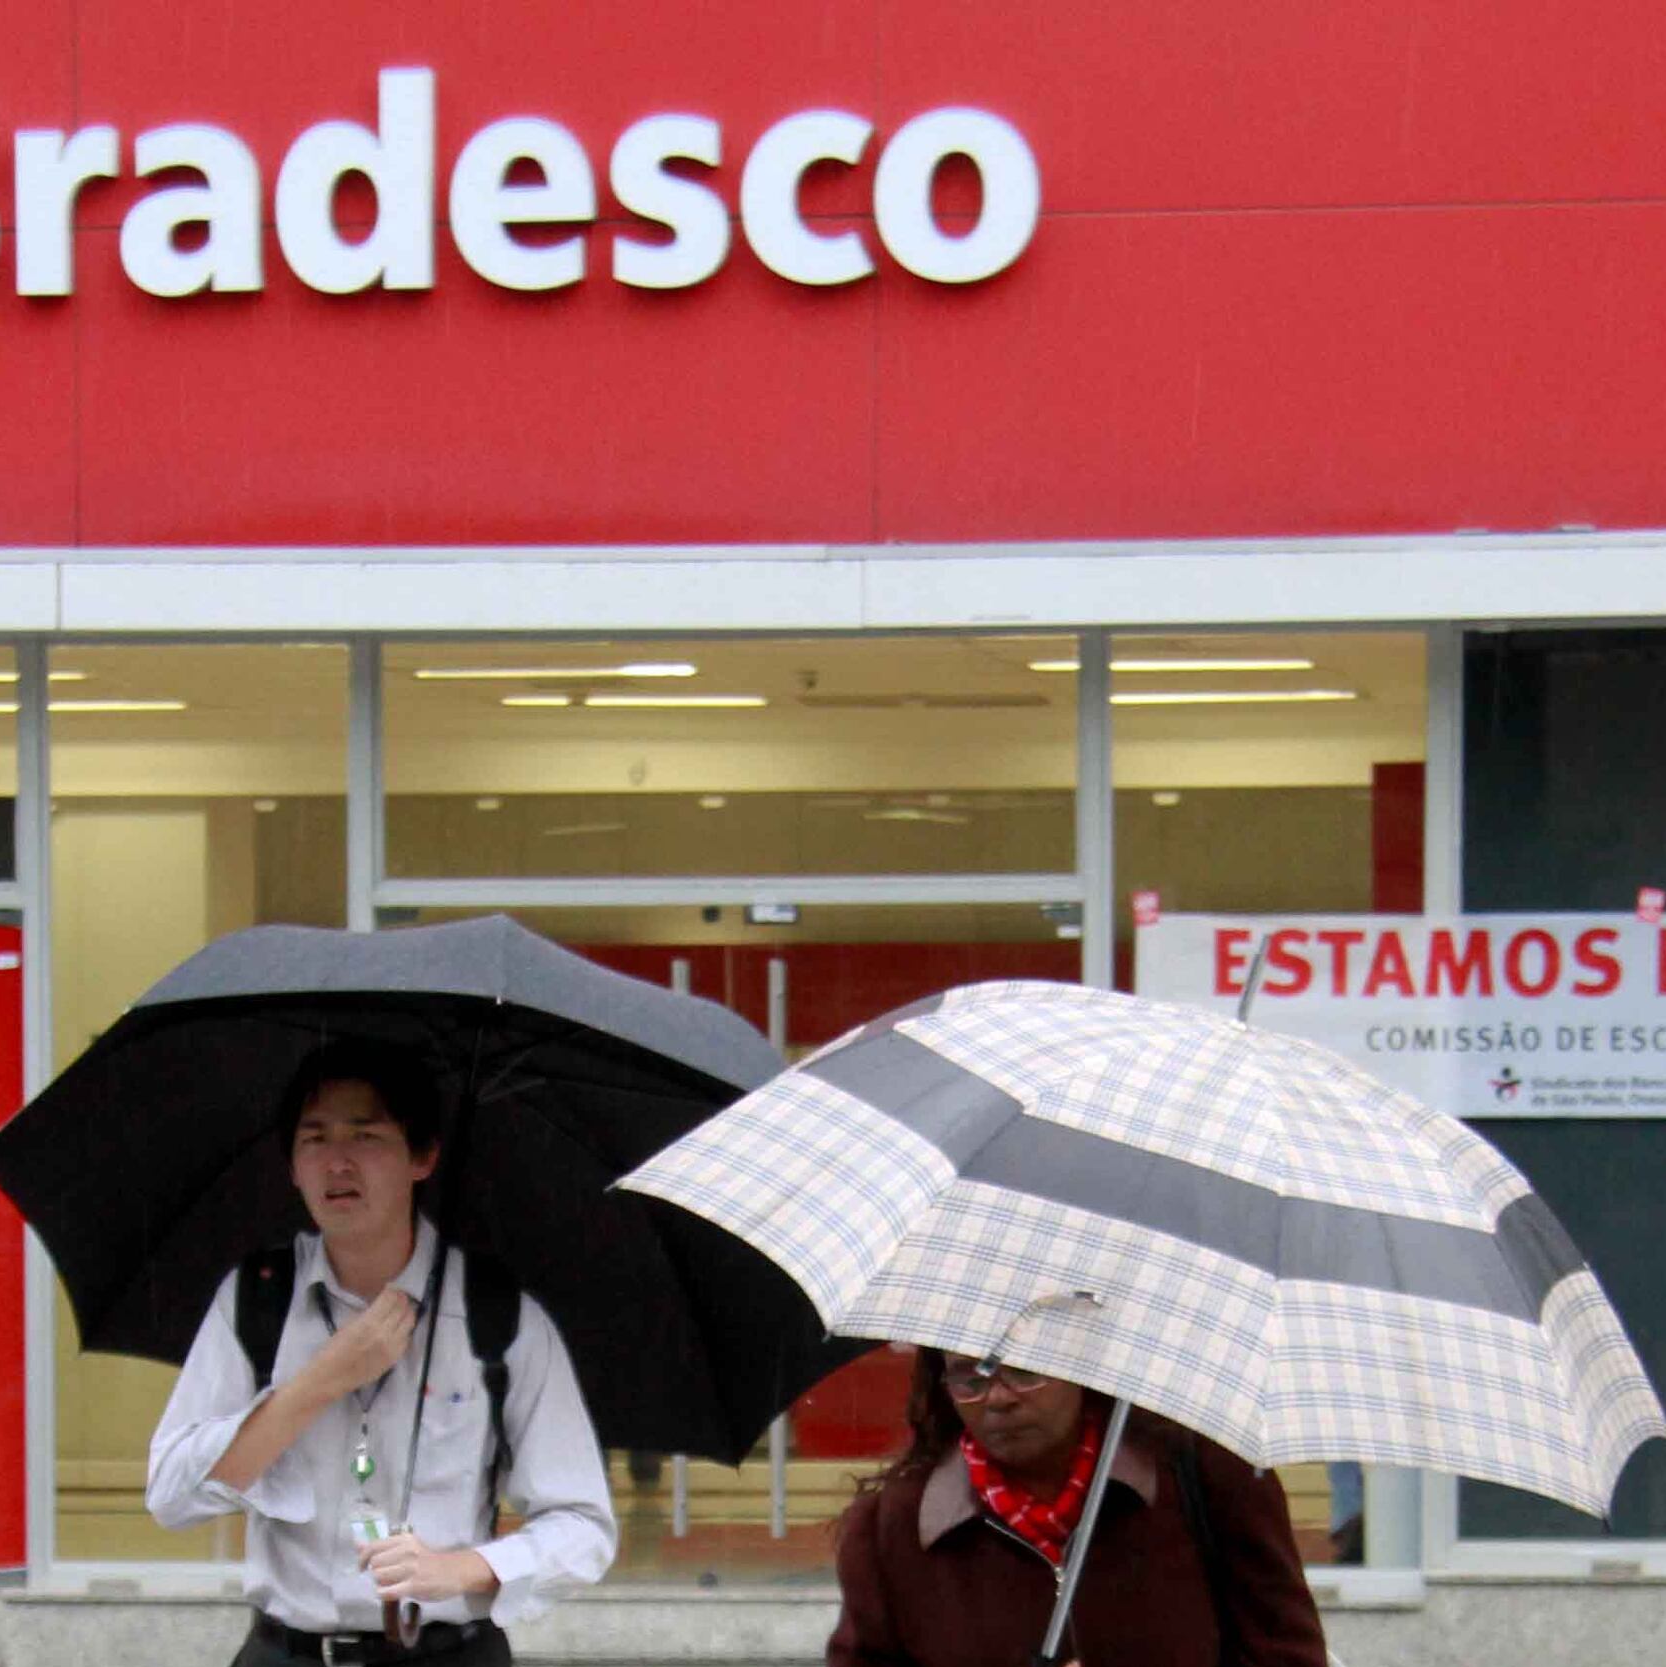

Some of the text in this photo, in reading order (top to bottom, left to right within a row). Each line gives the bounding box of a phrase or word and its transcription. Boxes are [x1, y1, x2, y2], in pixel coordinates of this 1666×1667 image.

[1213, 926, 1624, 998] ESTAMOS
[1365, 1021, 1541, 1052] COMISSÃO
[1555, 1025, 1595, 1051] DE
